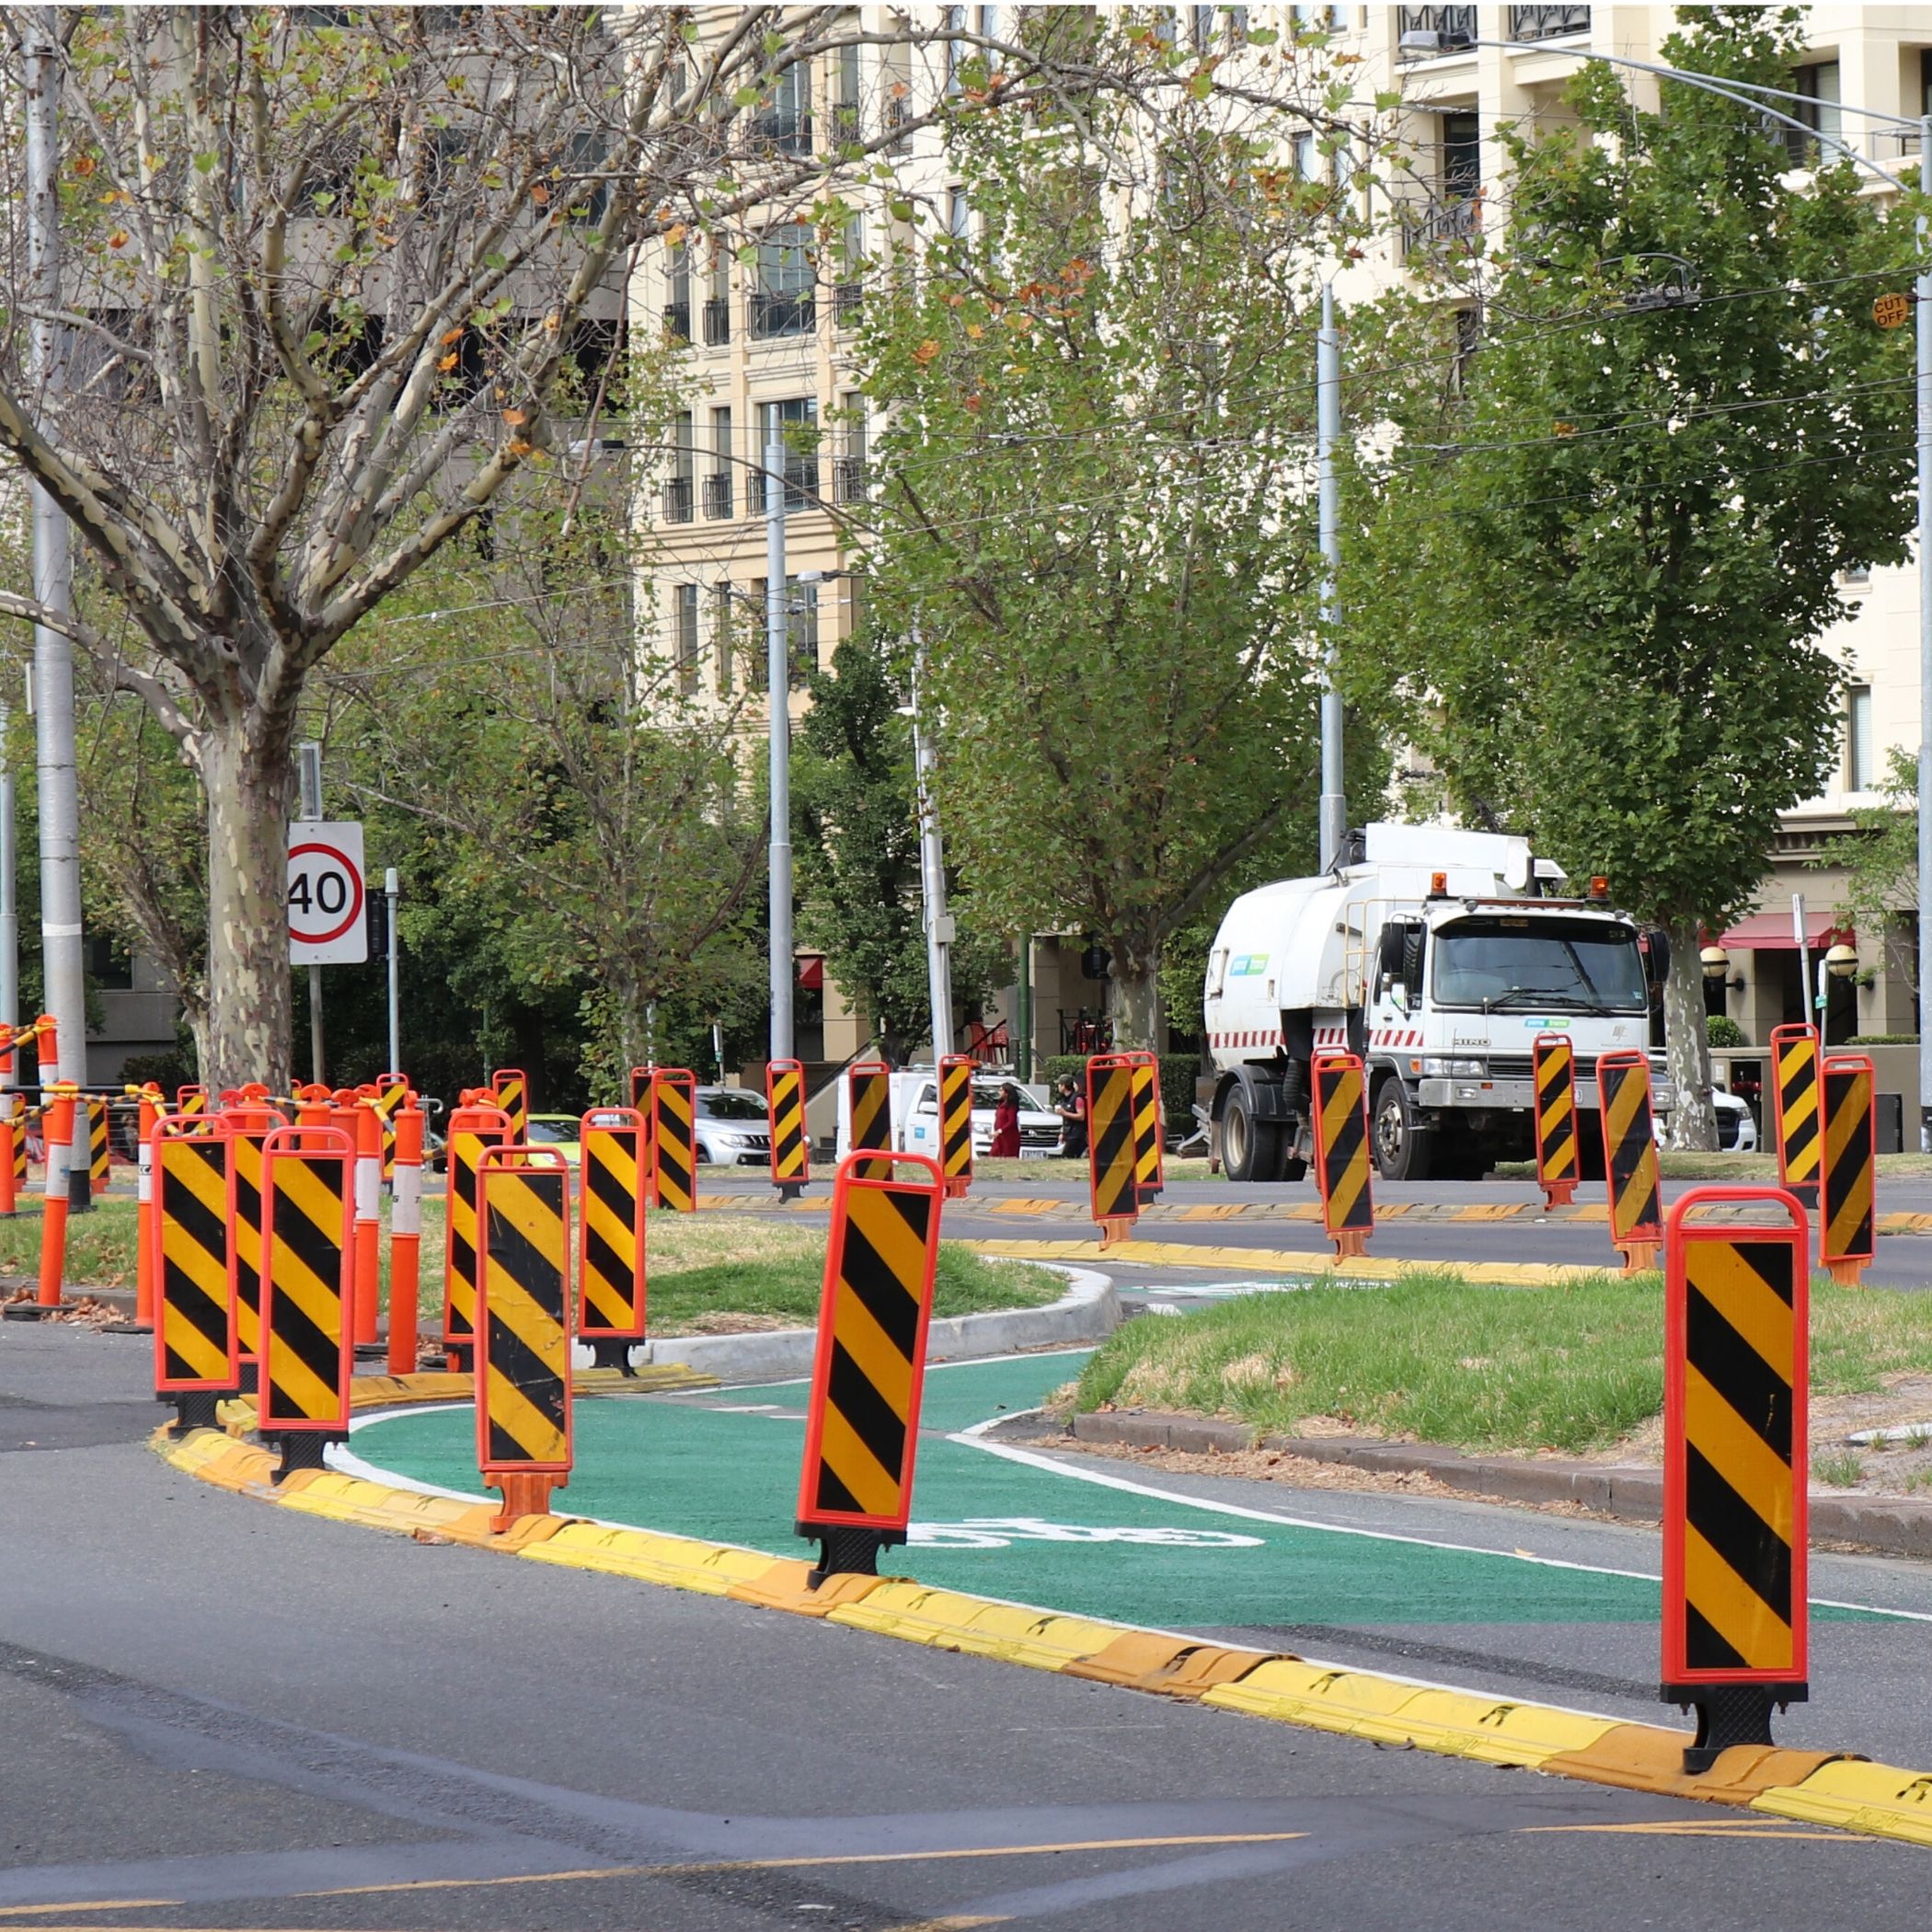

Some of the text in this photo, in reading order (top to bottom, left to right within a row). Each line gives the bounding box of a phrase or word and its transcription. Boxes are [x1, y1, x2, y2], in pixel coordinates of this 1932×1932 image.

[1874, 297, 1902, 314] CUT
[1877, 309, 1903, 326] OFF
[288, 871, 346, 914] 40
